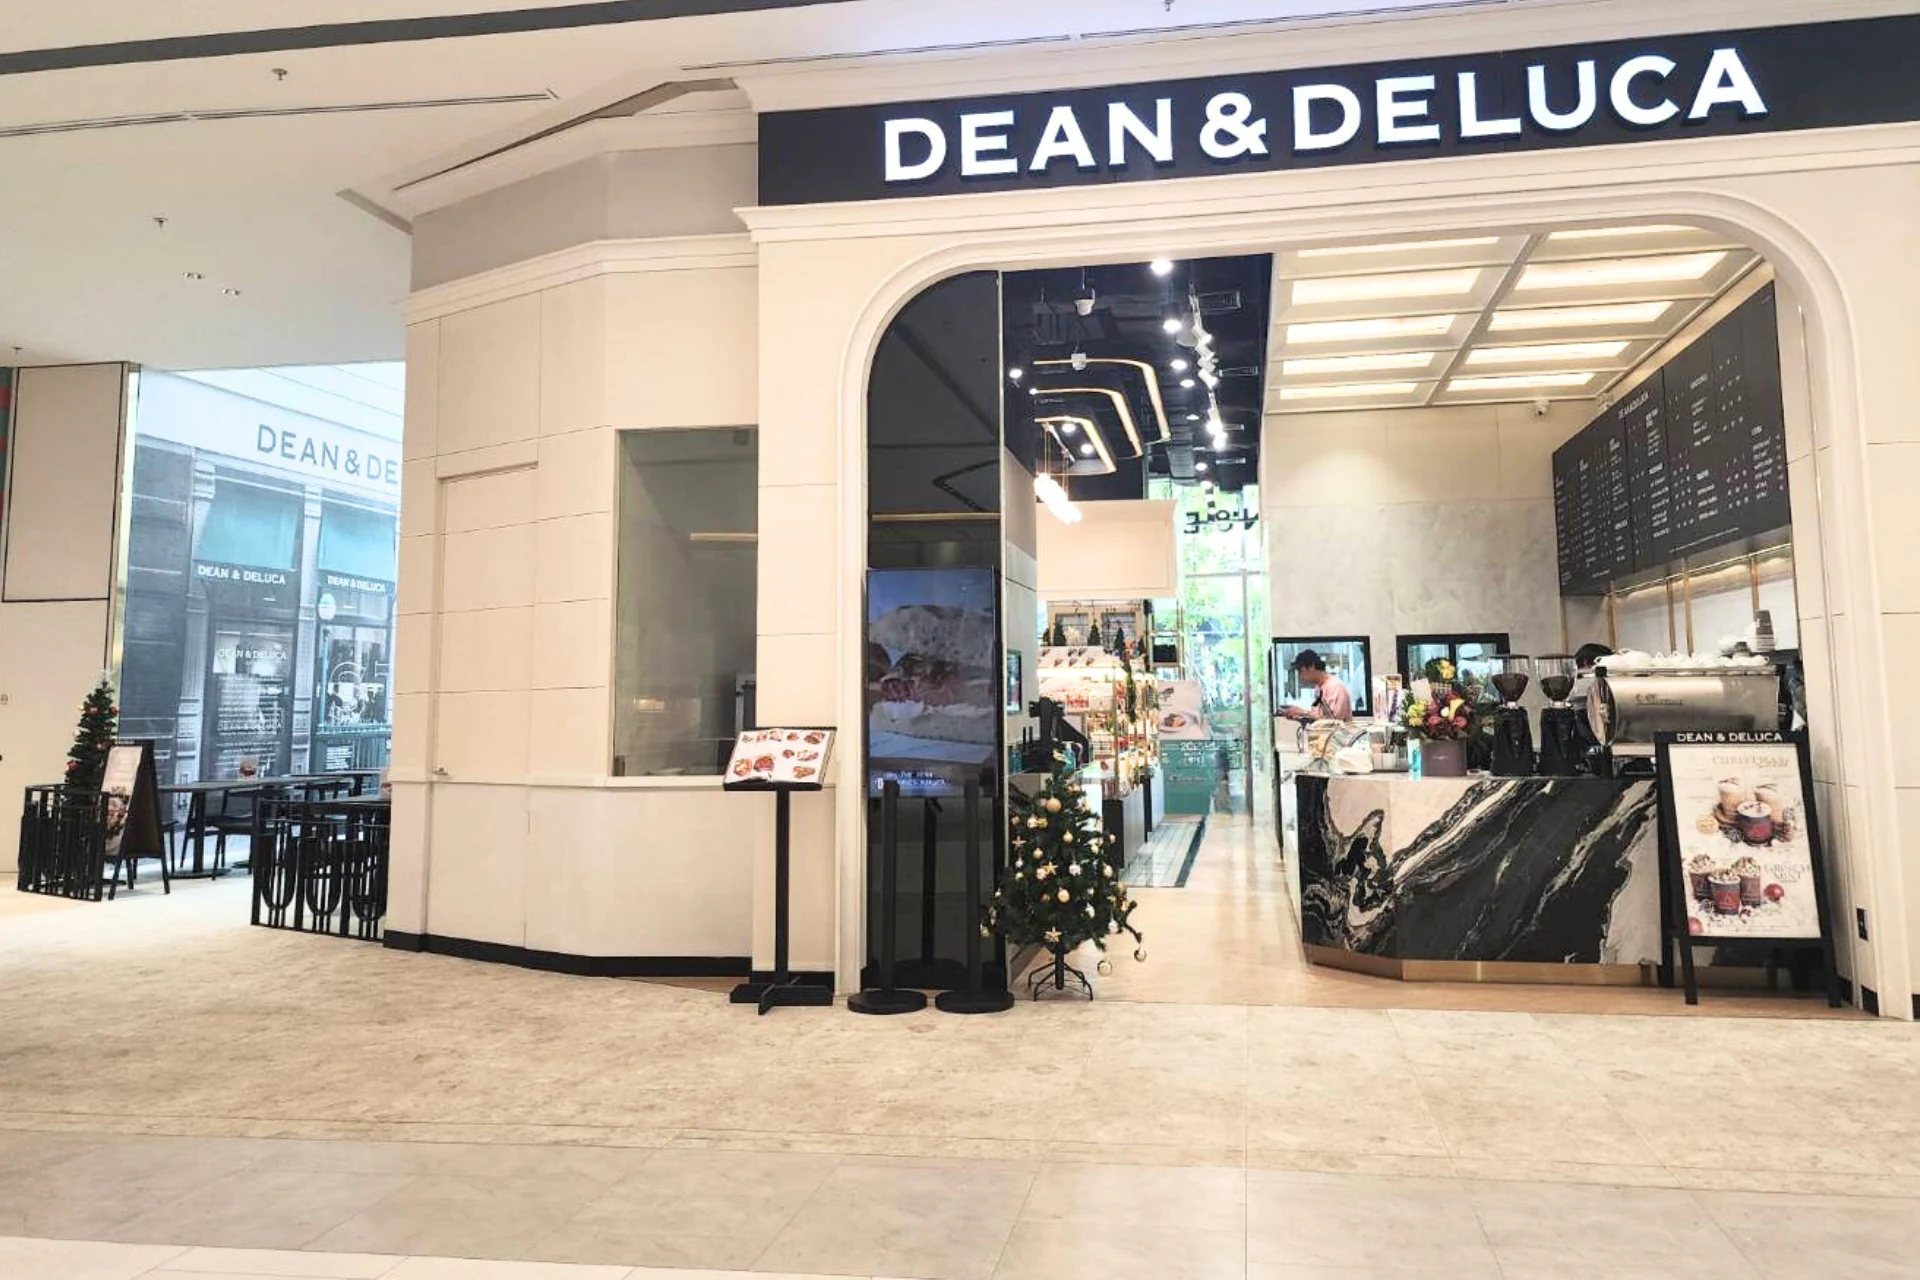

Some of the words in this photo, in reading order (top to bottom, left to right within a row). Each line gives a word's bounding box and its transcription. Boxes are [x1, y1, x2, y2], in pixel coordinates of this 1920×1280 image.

[884, 98, 1173, 182] DEAN
[1199, 92, 1269, 159] &
[1292, 47, 1768, 150] DELUCA
[257, 423, 339, 470] DEAN
[345, 449, 361, 476] &
[367, 454, 399, 485] DE
[197, 565, 229, 579] DEAN
[232, 571, 241, 580] &
[243, 572, 286, 586] DELUCA
[327, 575, 349, 587] DEAN
[356, 579, 386, 593] DELUCA
[1676, 732, 1713, 742] DEAN
[1716, 732, 1726, 742] &
[1728, 732, 1783, 742] DELUCA
